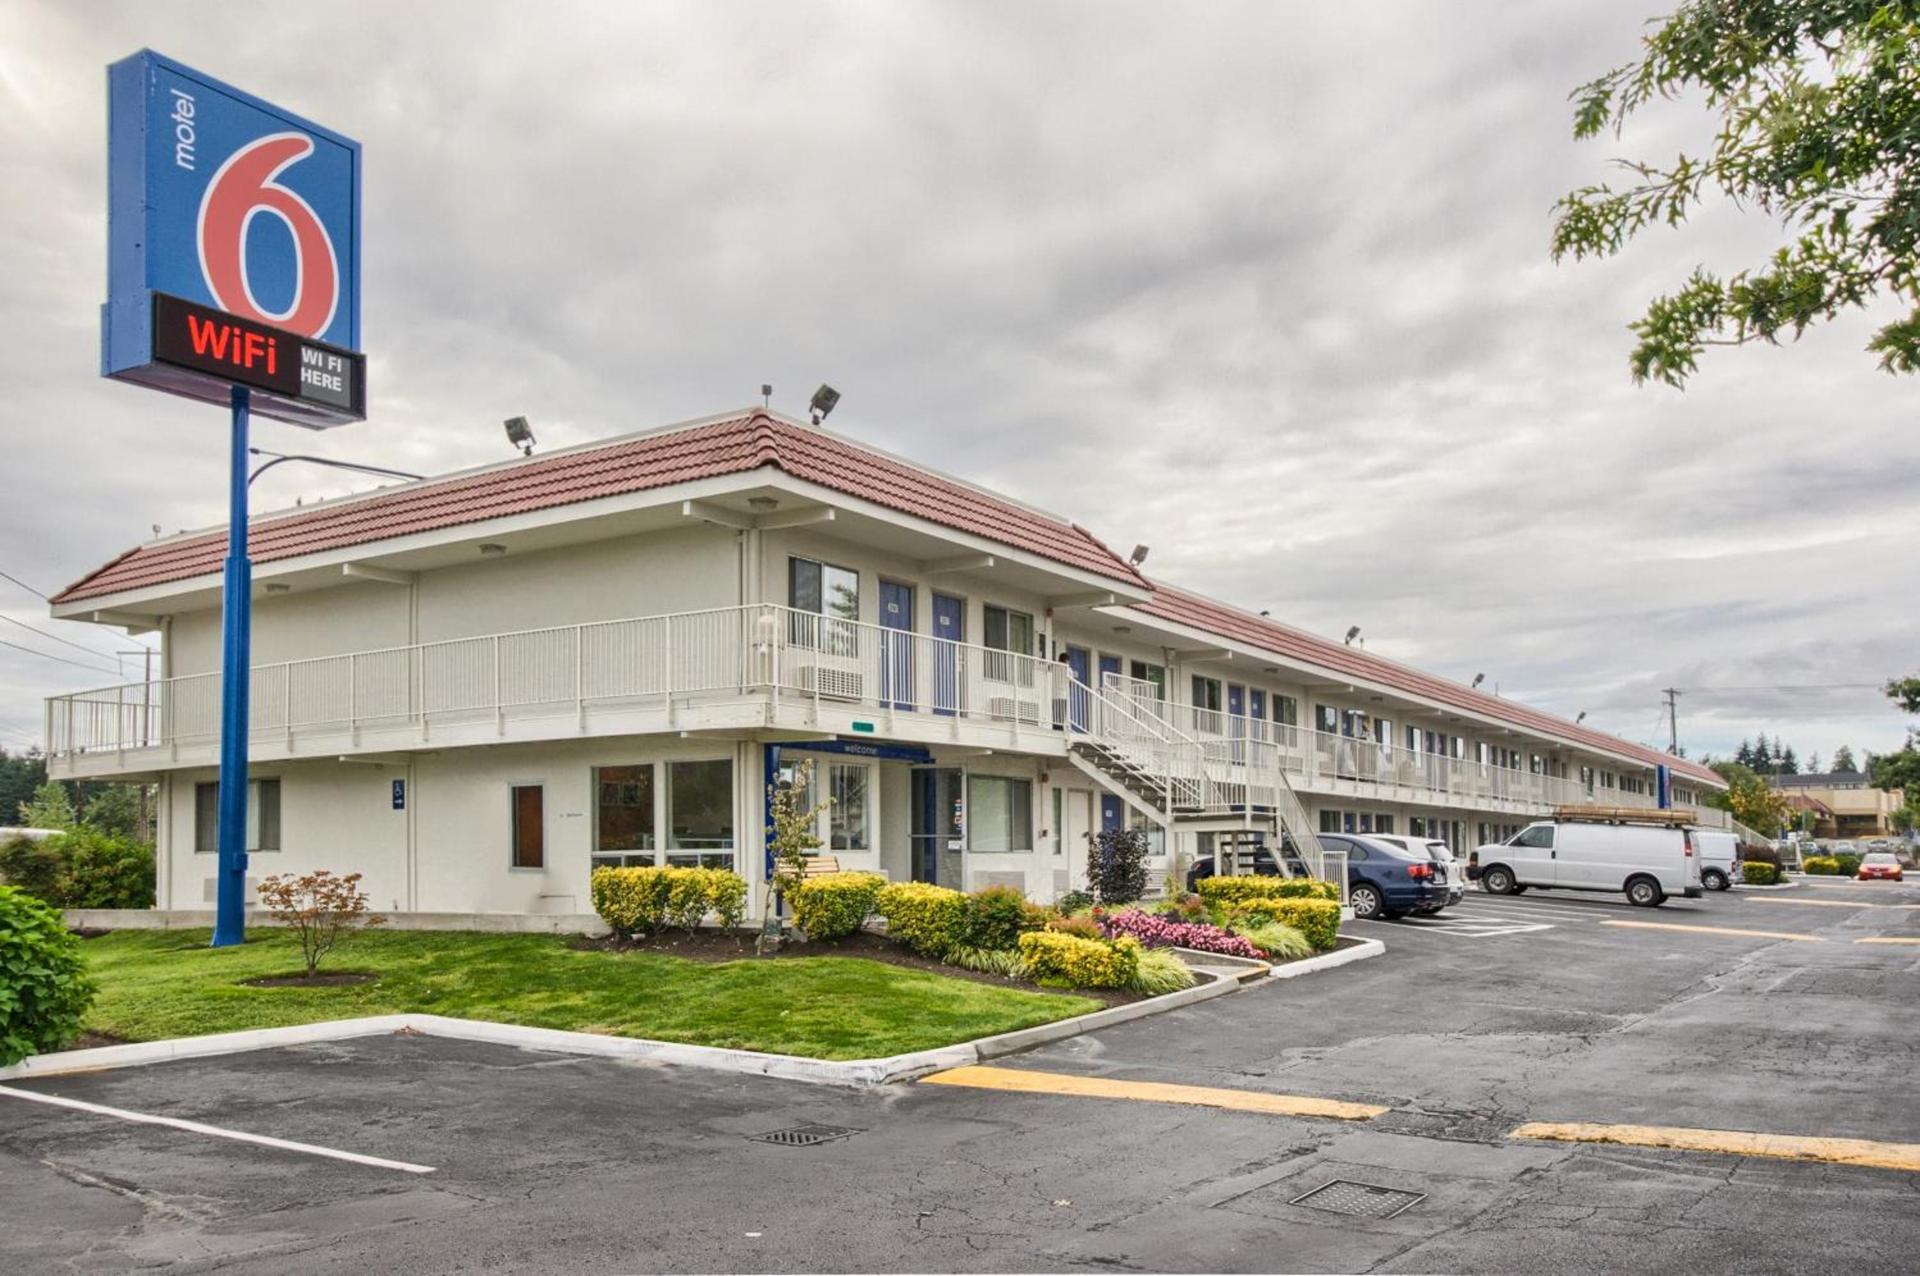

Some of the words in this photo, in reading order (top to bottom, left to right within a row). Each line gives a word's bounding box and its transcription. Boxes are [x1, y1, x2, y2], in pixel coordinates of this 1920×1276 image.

[171, 89, 196, 171] motel
[197, 131, 340, 341] 6
[187, 314, 277, 375] WiFi
[302, 347, 324, 368] WI
[328, 354, 342, 373] FI
[301, 367, 342, 391] HERE
[844, 743, 879, 755] welcome
